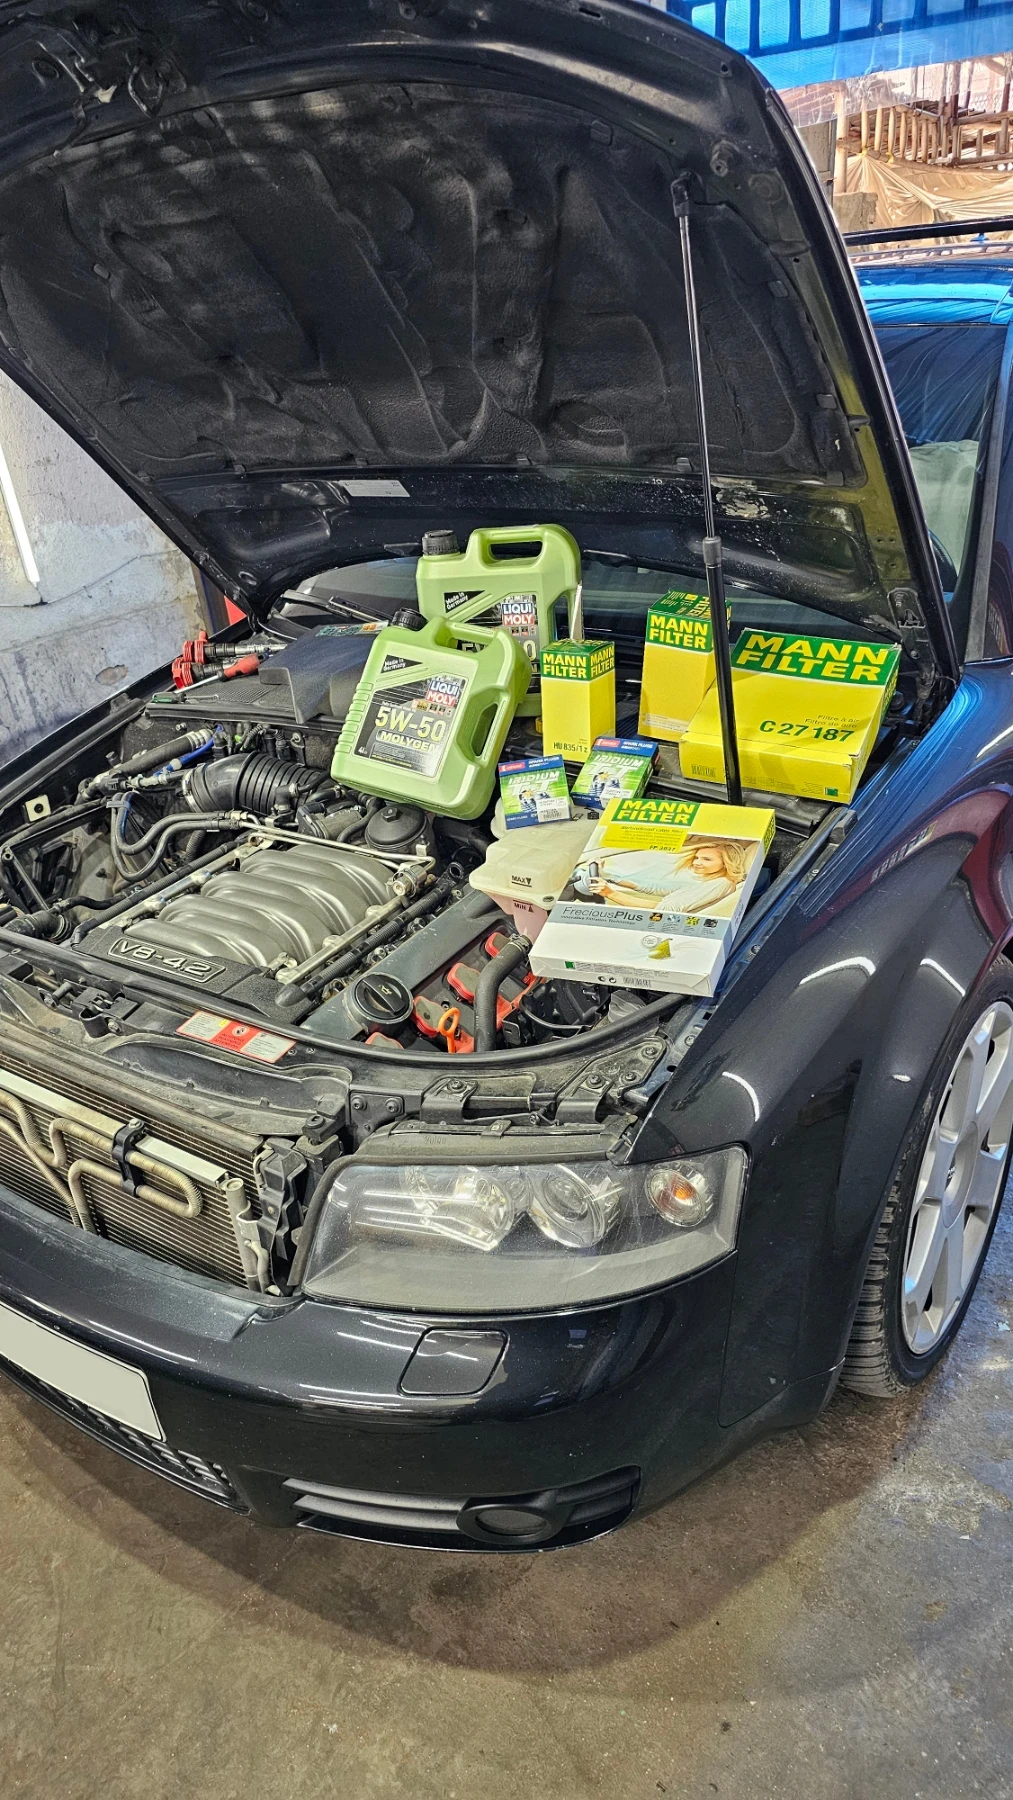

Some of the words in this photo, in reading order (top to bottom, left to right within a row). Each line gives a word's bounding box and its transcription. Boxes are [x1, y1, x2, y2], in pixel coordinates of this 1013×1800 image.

[445, 595, 459, 605] Made
[446, 596, 469, 610] Germany
[503, 603, 532, 614] LIQUI
[504, 614, 533, 625] MOLY
[650, 614, 708, 636] MANN
[649, 627, 706, 649] FILTER
[590, 645, 615, 667] MANN
[745, 633, 888, 665] MANN
[383, 662, 406, 672] Germany
[543, 653, 587, 667] MANN
[736, 650, 881, 681] FILTER
[543, 665, 587, 679] FILTER
[590, 658, 615, 678] FILTER
[431, 680, 459, 695] LIQUI
[426, 691, 456, 707] MOLY
[375, 705, 447, 742] 5W-50
[759, 720, 776, 733] C
[380, 730, 442, 754] MOLYGEN
[553, 742, 562, 750] HU
[563, 742, 583, 752] 835/1
[594, 754, 644, 768] IRIDIUM
[508, 771, 560, 785] IRIDIUM
[622, 800, 695, 814] MANN
[617, 809, 690, 824] FILTER
[511, 875, 526, 884] MAX
[513, 902, 527, 910] MIN
[562, 906, 644, 922] FreciousPlus
[120, 941, 212, 977] V8-4.2
